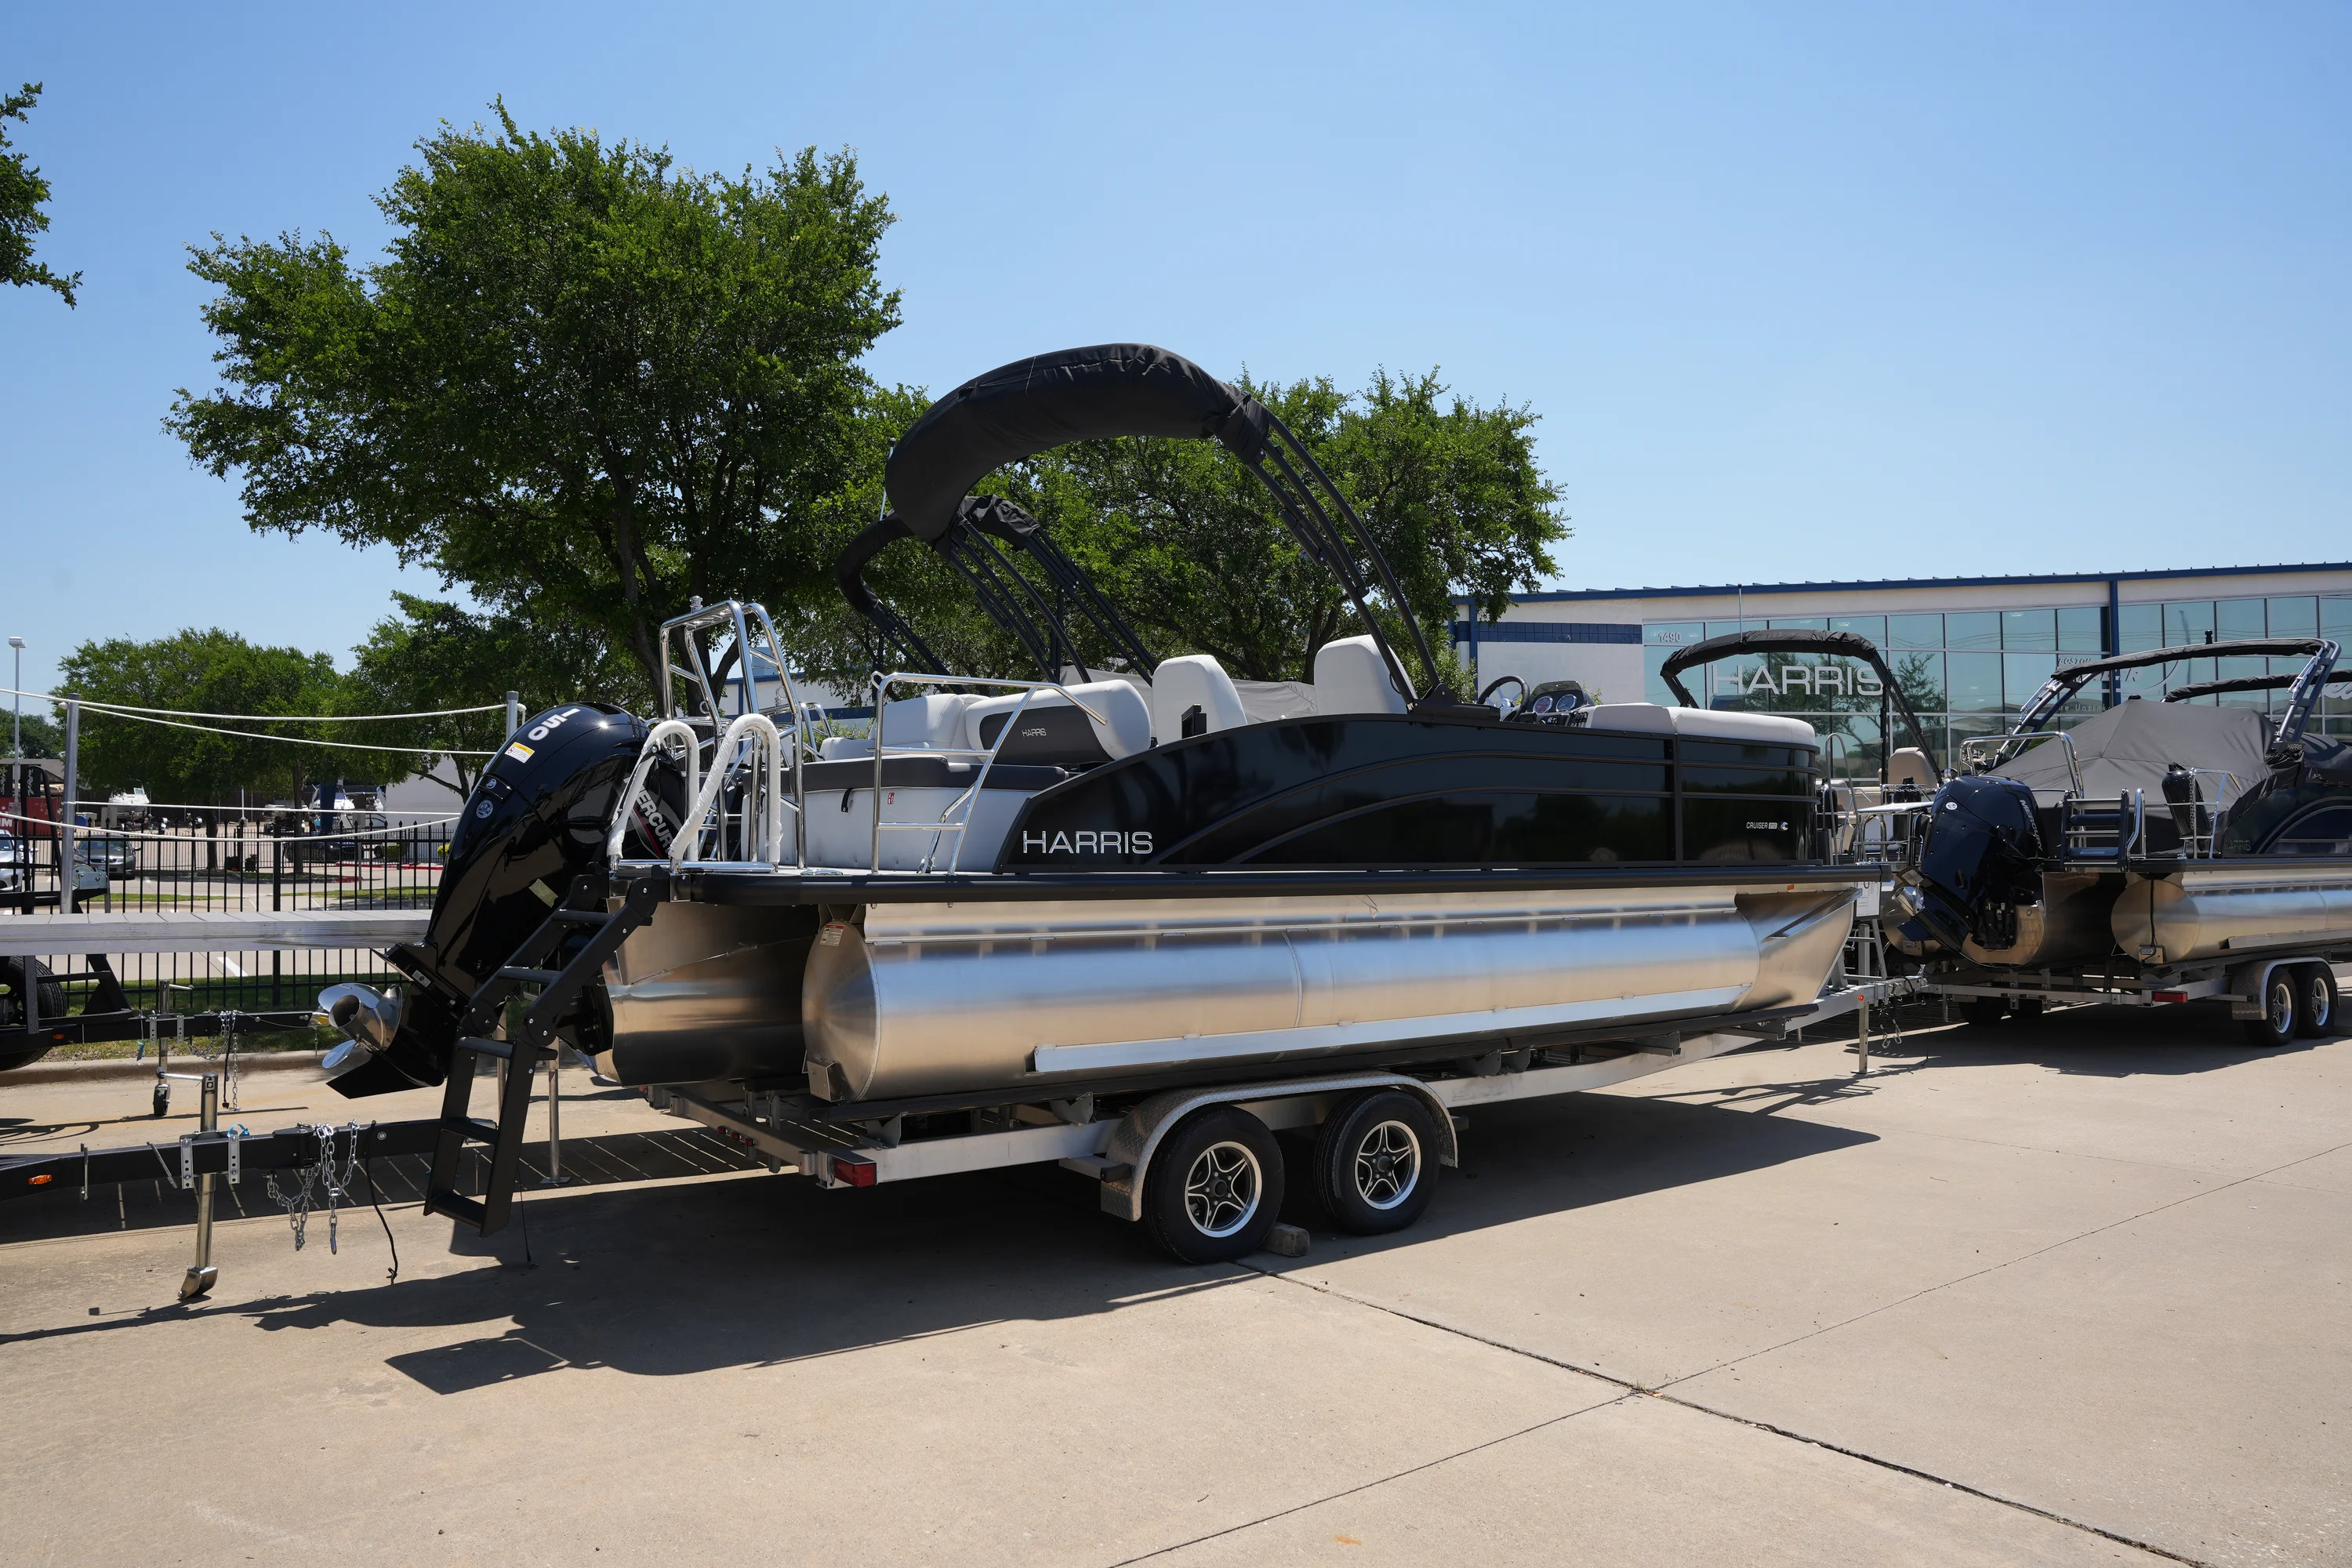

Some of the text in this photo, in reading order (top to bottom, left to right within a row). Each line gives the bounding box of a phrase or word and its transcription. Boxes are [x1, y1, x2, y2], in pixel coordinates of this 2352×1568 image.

[1657, 631, 1681, 642] 1490
[1711, 665, 1884, 695] HARRIS
[528, 708, 581, 741] 150
[1022, 728, 1047, 737] HARRIS
[623, 777, 675, 853] ERCUR
[2020, 800, 2043, 852] MERCURY
[1022, 830, 1153, 855] HARRIS
